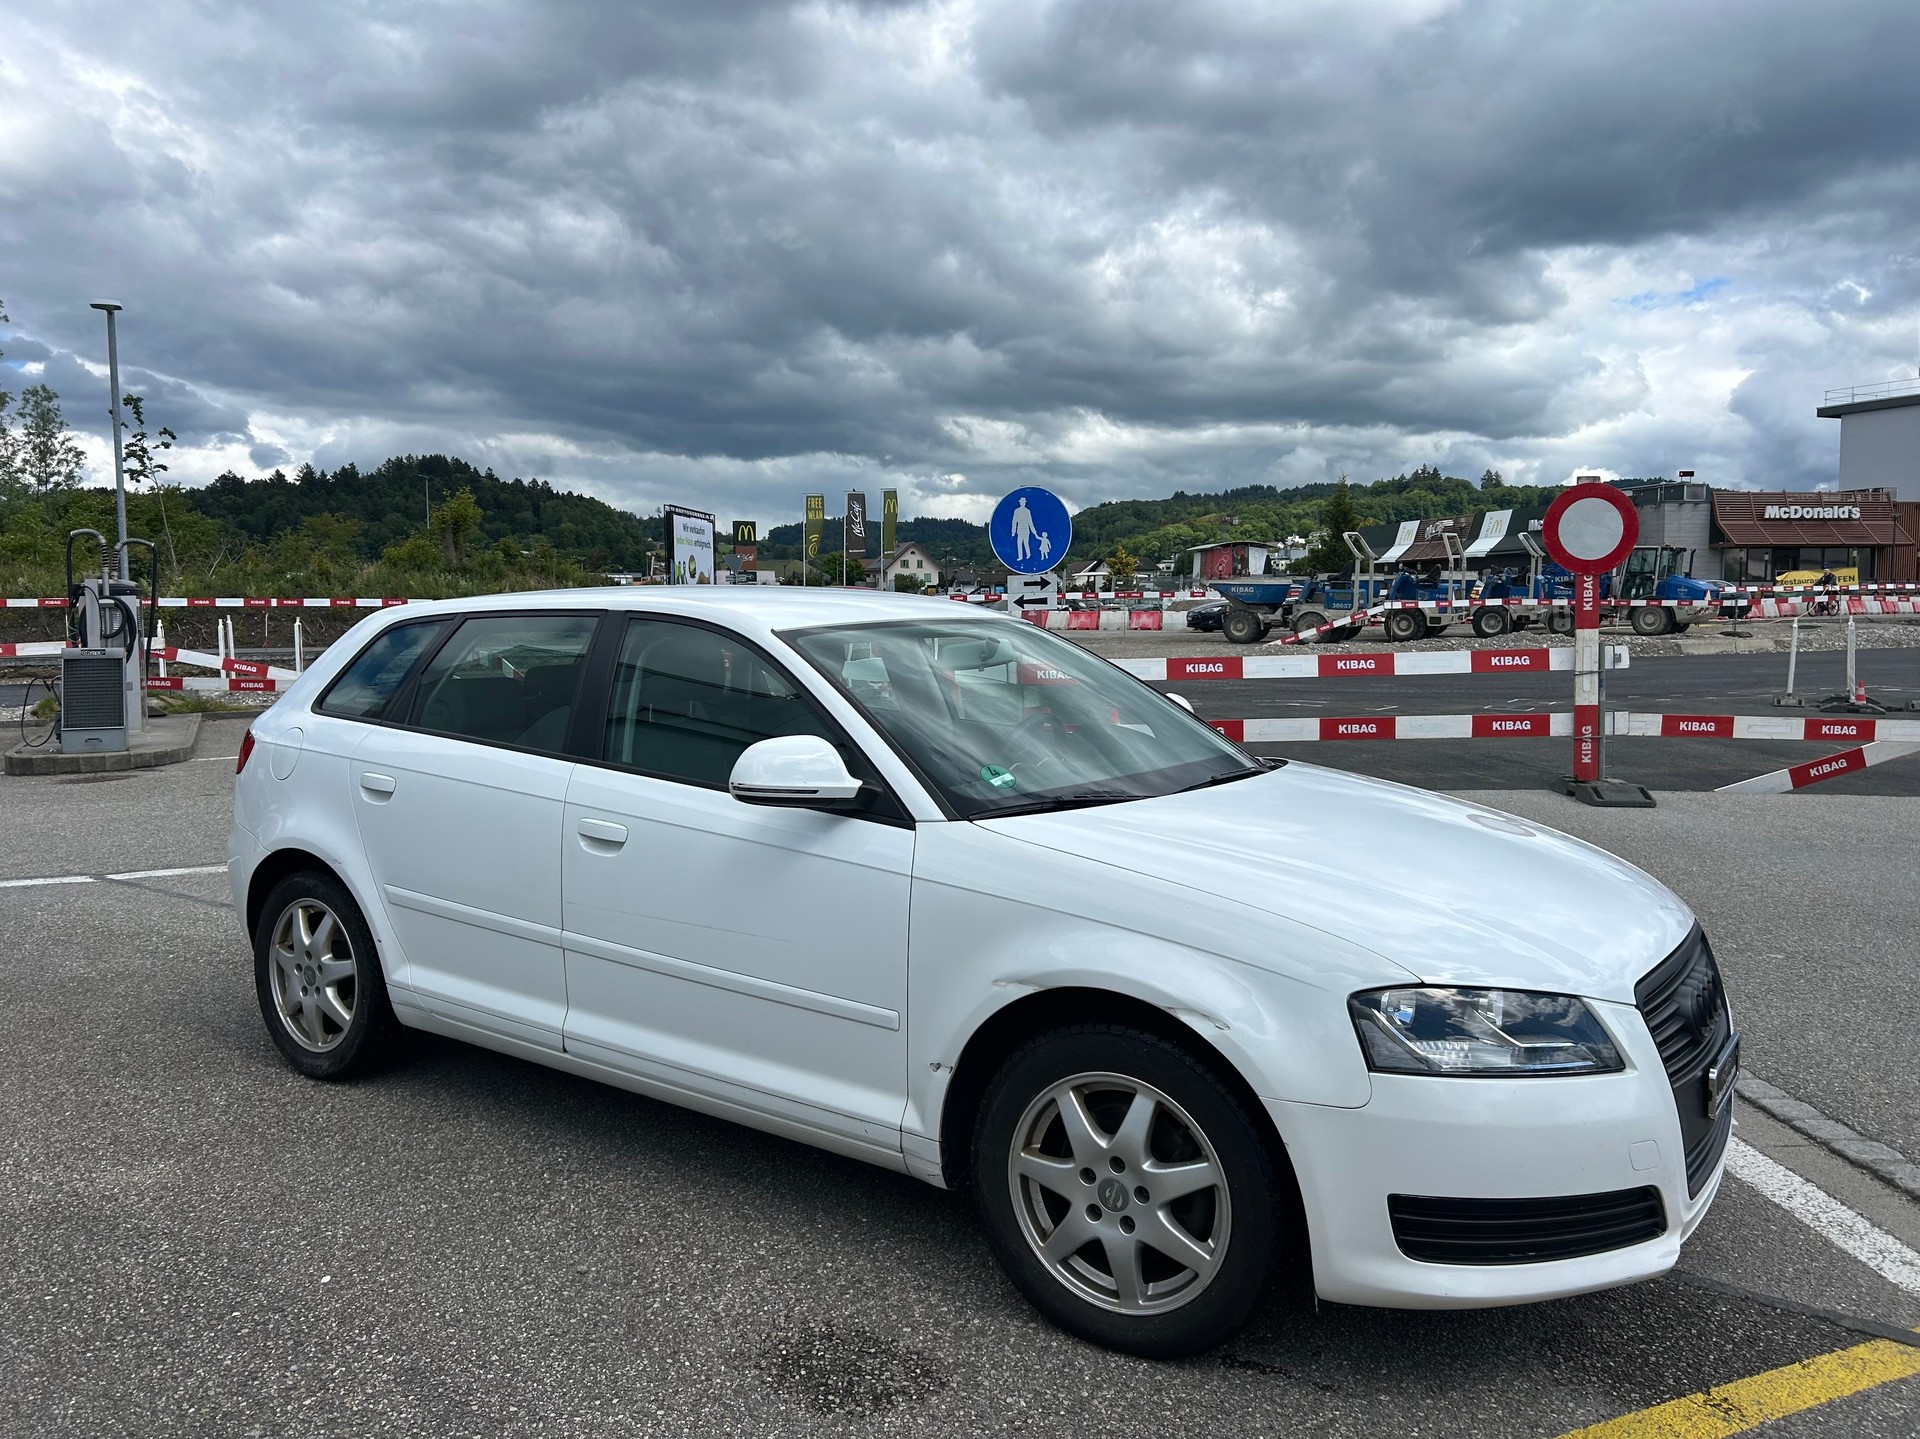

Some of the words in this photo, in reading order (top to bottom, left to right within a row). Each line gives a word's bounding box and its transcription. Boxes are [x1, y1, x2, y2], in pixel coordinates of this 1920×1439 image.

[807, 497, 823, 509] FREE
[807, 510, 824, 520] WLAN
[1764, 505, 1861, 519] McDonald's
[1337, 659, 1376, 670] KIBAG
[1491, 656, 1530, 666] KIBAG
[233, 663, 257, 673] KIBAG
[1185, 663, 1224, 673] KIBAG
[147, 679, 172, 687] KIBAG
[1338, 723, 1377, 734] KIBAG
[1492, 720, 1531, 731] KIBAG
[1679, 721, 1716, 732] KIBAG
[1821, 725, 1857, 735] KIBAG
[1581, 725, 1592, 763] KIBAG
[1809, 758, 1848, 777] KIBAG
